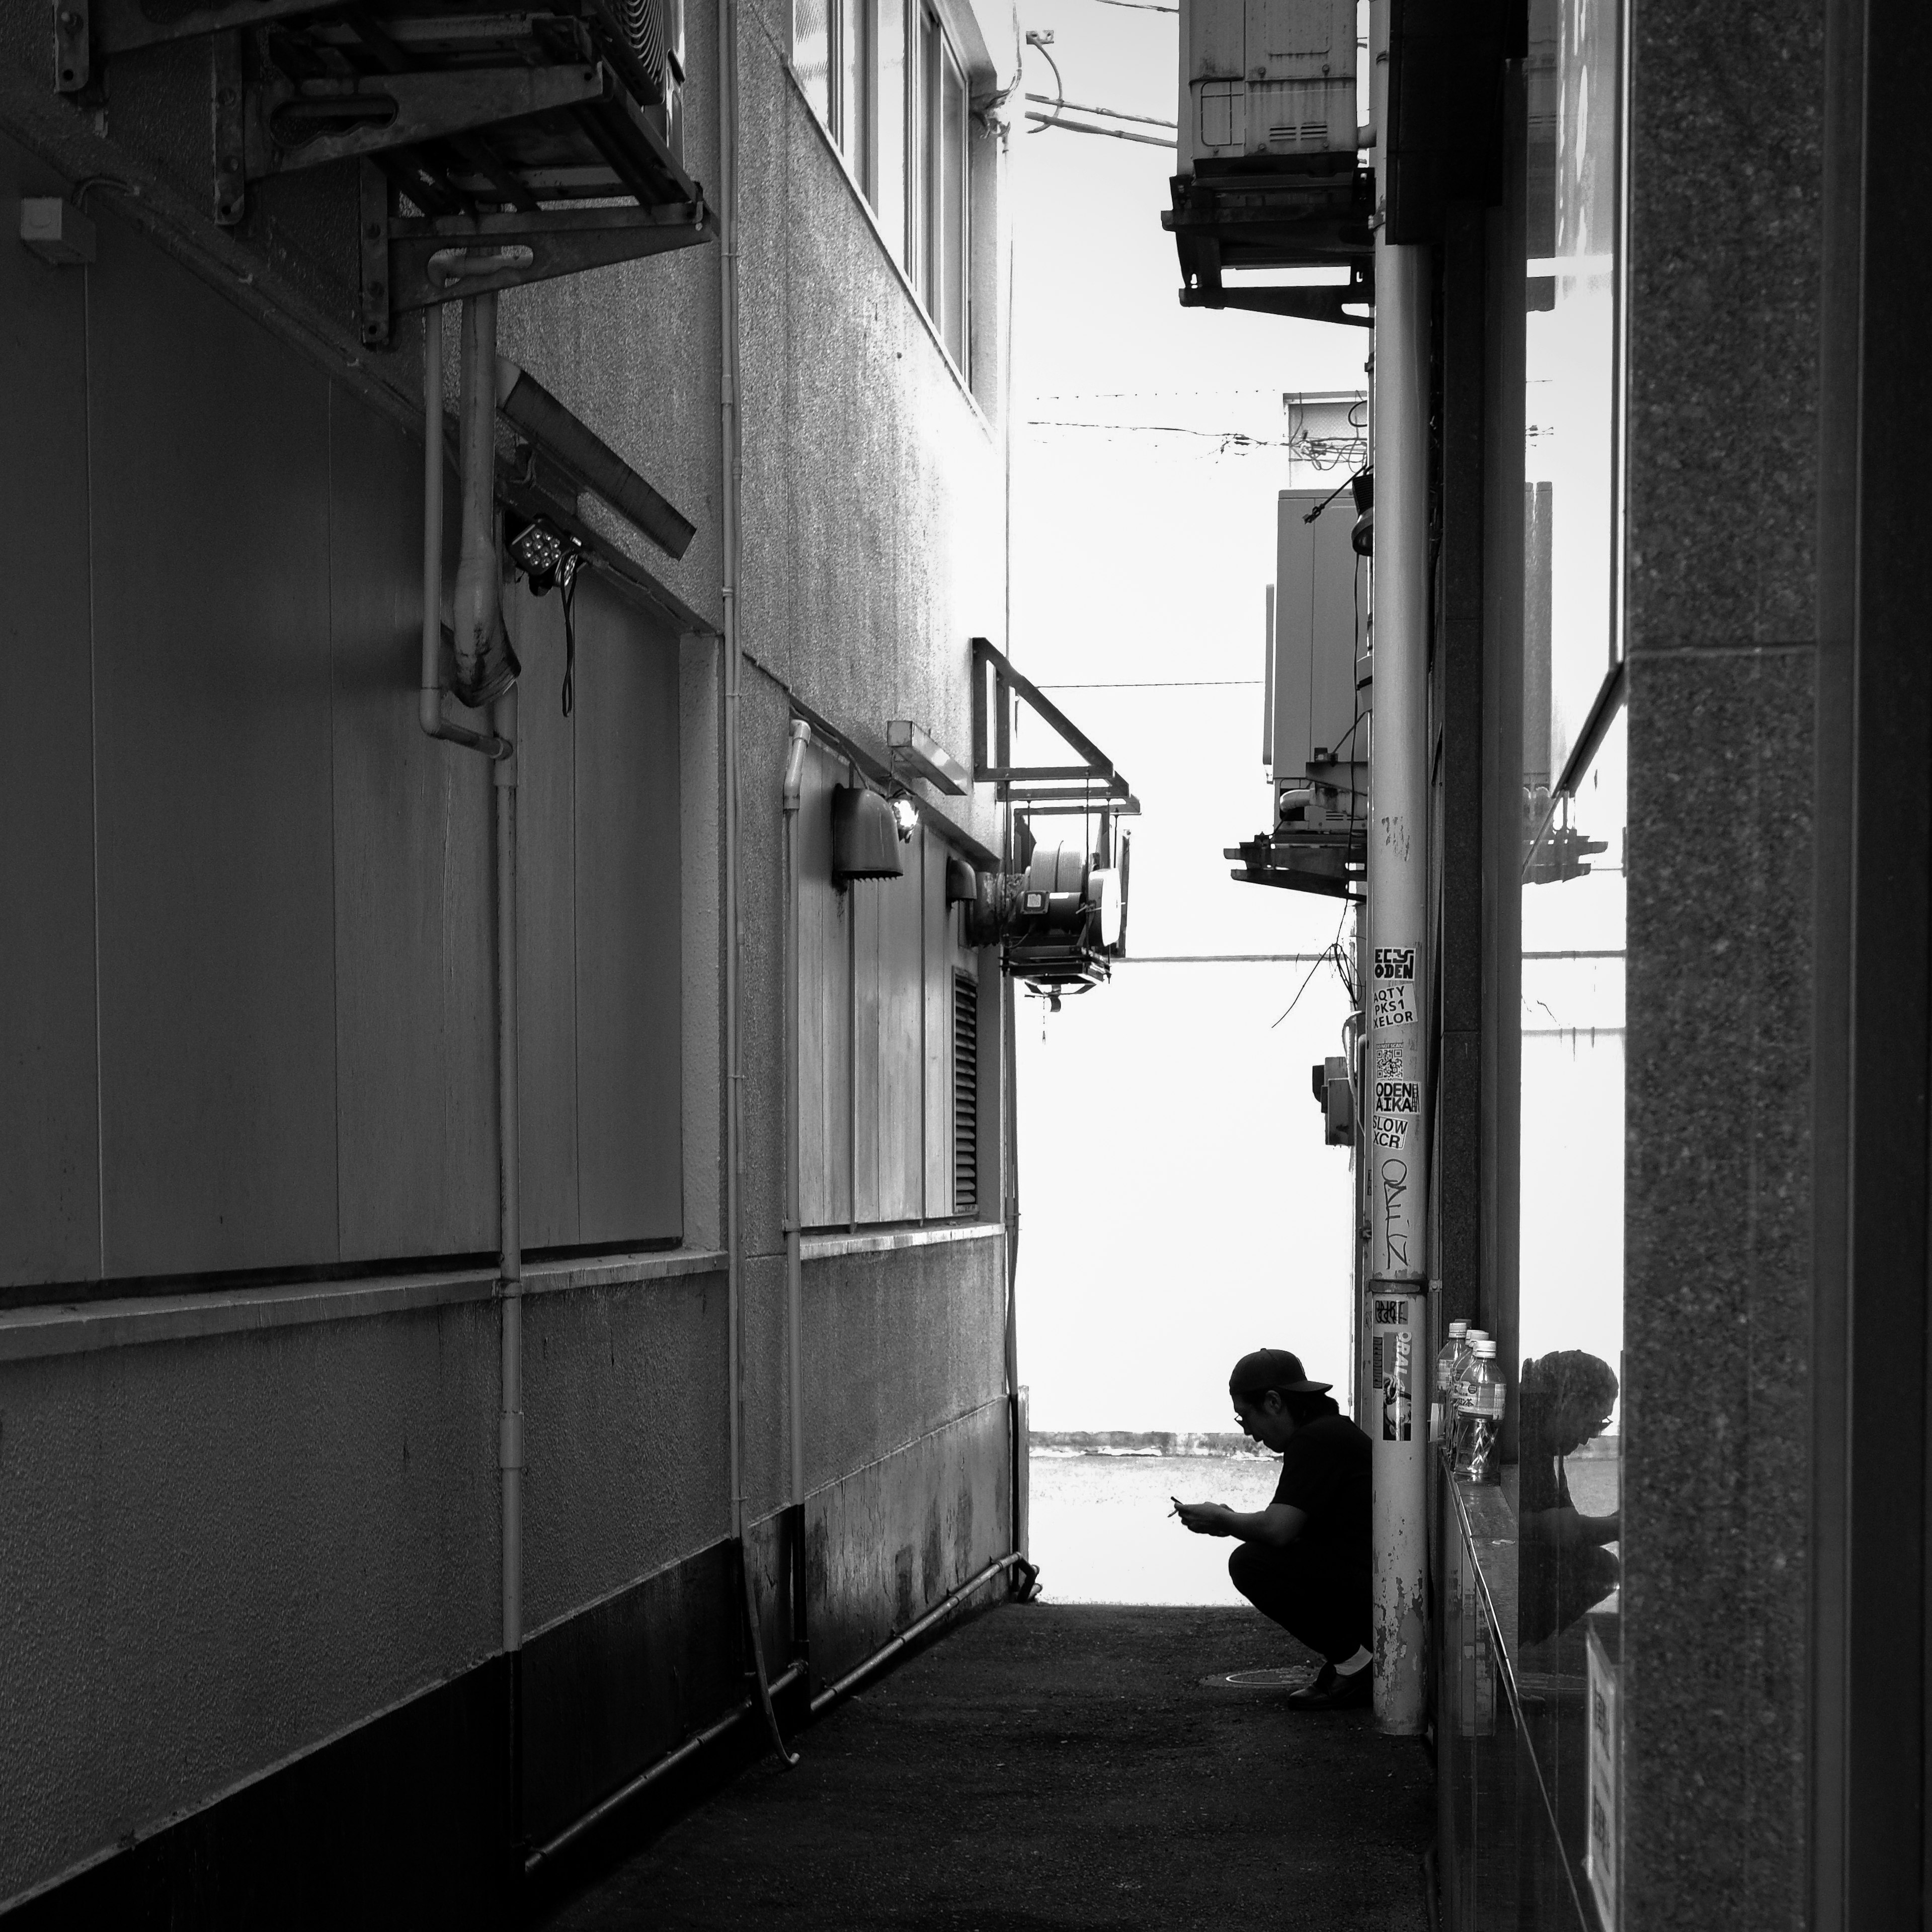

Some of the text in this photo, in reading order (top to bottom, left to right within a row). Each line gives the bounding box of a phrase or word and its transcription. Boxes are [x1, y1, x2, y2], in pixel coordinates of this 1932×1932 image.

[1375, 958, 1414, 979] ODEN
[1374, 986, 1404, 1003] AQTY
[1375, 999, 1404, 1015] PKS1
[1374, 1011, 1413, 1029] XELOR
[1376, 1083, 1412, 1097] ODEN
[1373, 1115, 1408, 1135] SLOW
[1374, 1130, 1400, 1149] XCR
